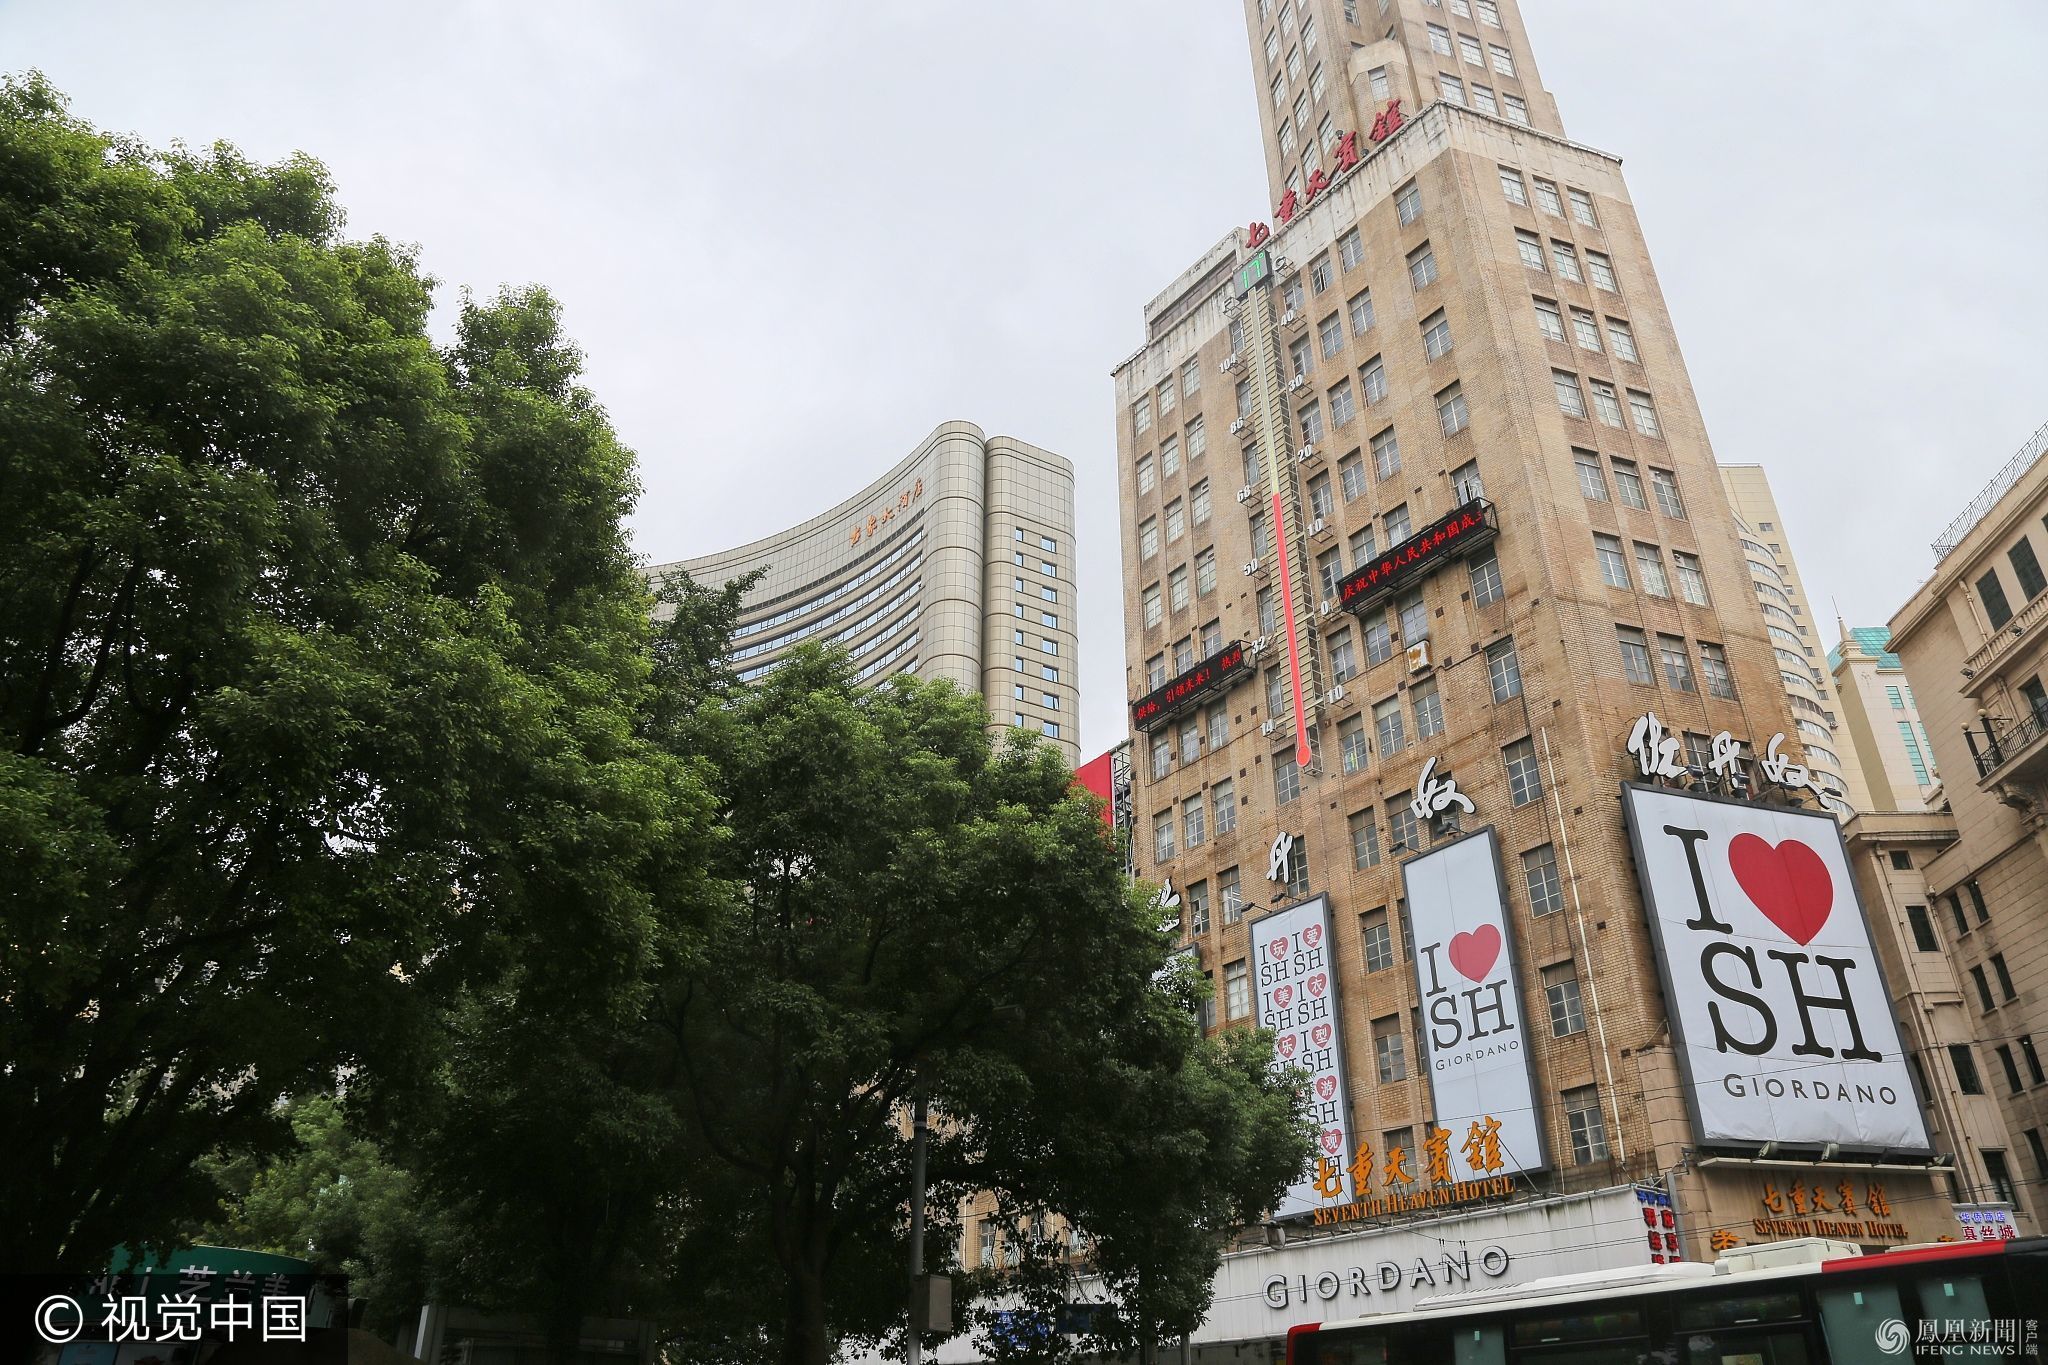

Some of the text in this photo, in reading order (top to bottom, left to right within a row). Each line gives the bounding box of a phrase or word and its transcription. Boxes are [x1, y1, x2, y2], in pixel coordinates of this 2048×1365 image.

[1280, 309, 1296, 326] 40
[1218, 353, 1238, 374] 104
[1288, 375, 1304, 392] 30
[1230, 417, 1244, 435] 86
[1298, 444, 1313, 463] 20
[1237, 485, 1251, 503] 68
[1307, 518, 1323, 537] 10
[1243, 559, 1259, 576] 50
[1251, 636, 1266, 655] 32
[1260, 719, 1276, 736] 14
[1663, 824, 1734, 935] I
[1306, 928, 1318, 945] 爱
[1273, 941, 1285, 957] 玩
[1294, 946, 1324, 977] SH
[1420, 942, 1448, 998] I
[1261, 958, 1291, 988] SH
[1277, 989, 1290, 1005] 美
[1699, 941, 1883, 1063] SH
[1265, 1007, 1294, 1032] SH
[1298, 996, 1329, 1026] SH
[1430, 979, 1515, 1052] SH
[1315, 1028, 1328, 1044] 型
[1302, 1047, 1334, 1073] SH
[1435, 1040, 1519, 1071] GIORDANO
[1723, 1073, 1897, 1106] GIORDANO
[1325, 1133, 1337, 1149] 观
[1314, 1175, 1517, 1226] SEVENTH HEAVEN HOTEL
[1754, 1218, 1811, 1236] SEVENTH
[1813, 1220, 1864, 1238] HEAVEN
[1262, 1245, 1509, 1309] GIORDANO
